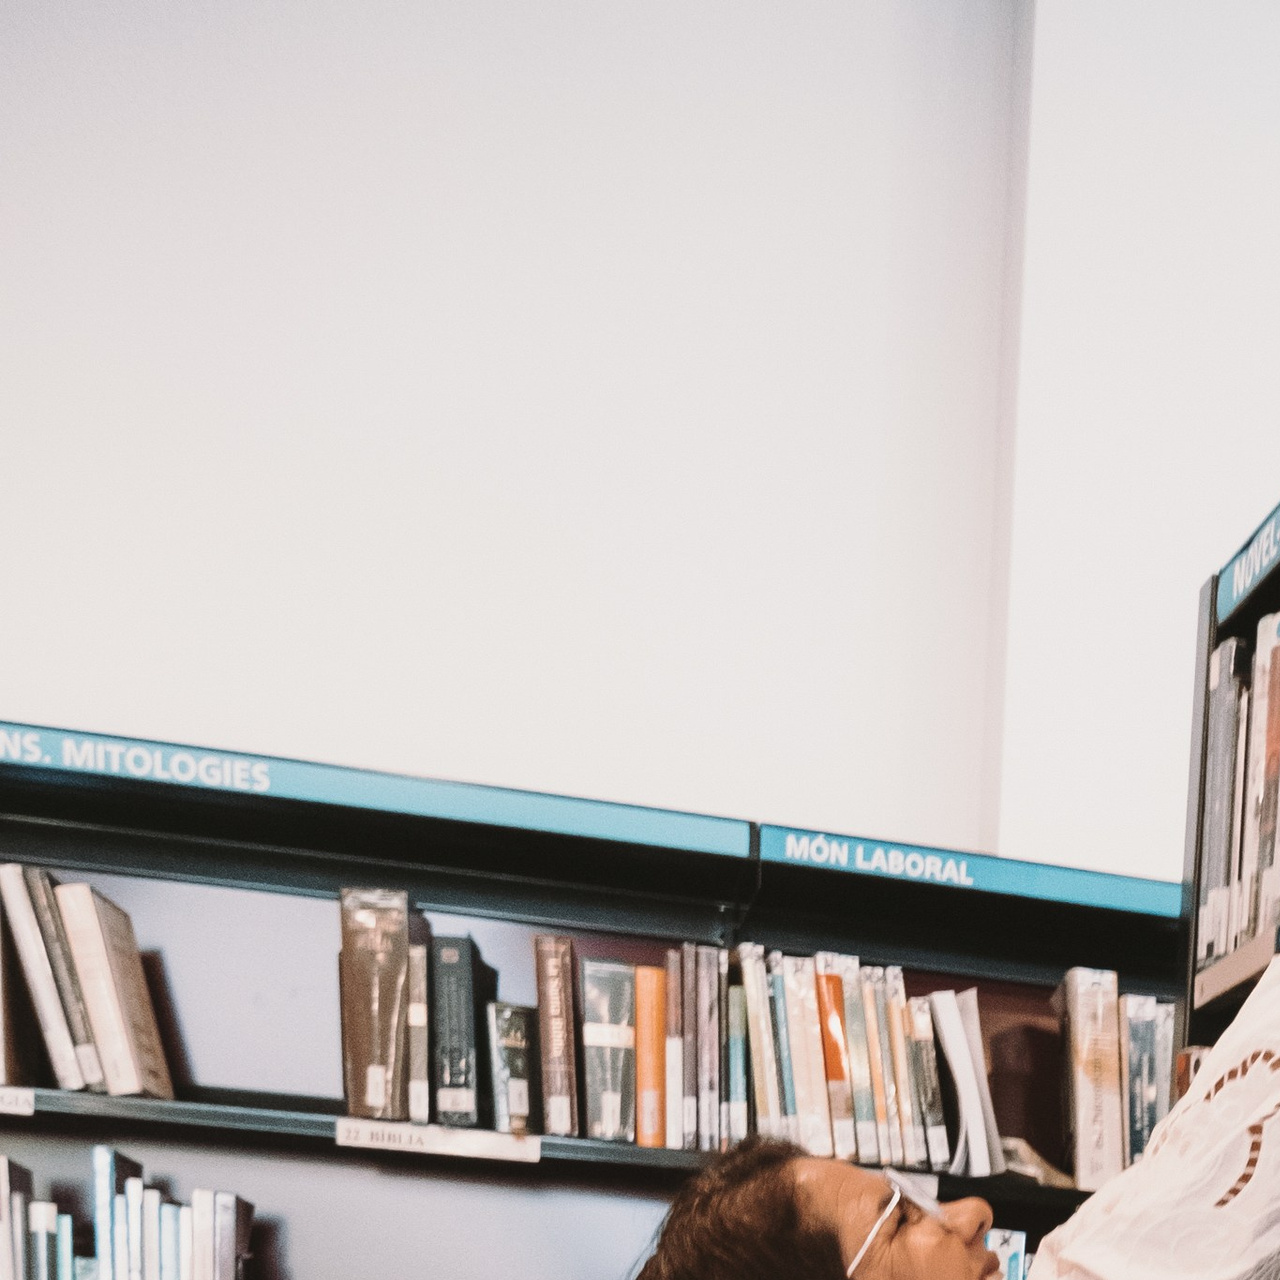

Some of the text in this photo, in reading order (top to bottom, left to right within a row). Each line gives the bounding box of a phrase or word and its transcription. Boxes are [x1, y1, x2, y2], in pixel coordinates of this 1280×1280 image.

[61, 738, 272, 793] MITOLOGIES
[785, 832, 974, 886] MÓN LABORAL
